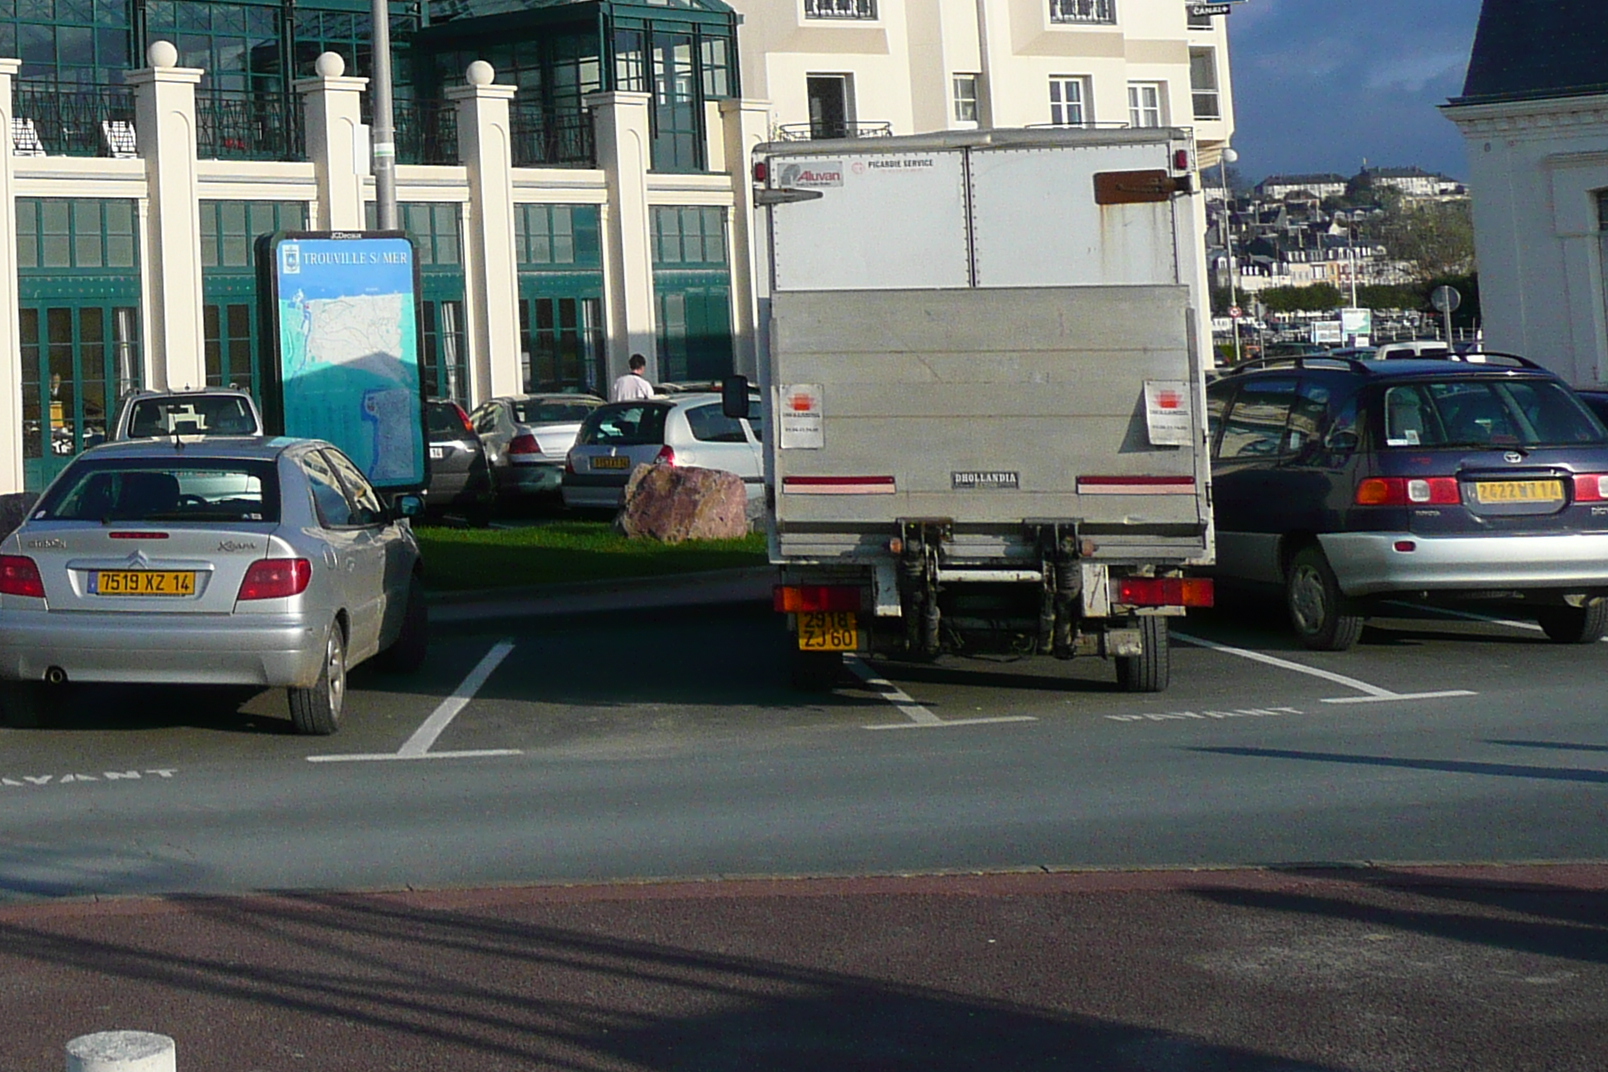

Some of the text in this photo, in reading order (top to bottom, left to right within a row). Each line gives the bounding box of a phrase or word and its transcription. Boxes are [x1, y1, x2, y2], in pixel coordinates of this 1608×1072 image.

[868, 159, 933, 168] PICARDIE SERVICE
[797, 170, 841, 182] Aluvan
[303, 251, 408, 264] TROUVILLE S/ MER
[955, 473, 1017, 483] DHOLLANDIA
[101, 574, 190, 591] 7519 XZ 14
[804, 611, 848, 628] 2918
[804, 629, 852, 647] ZJ 60
